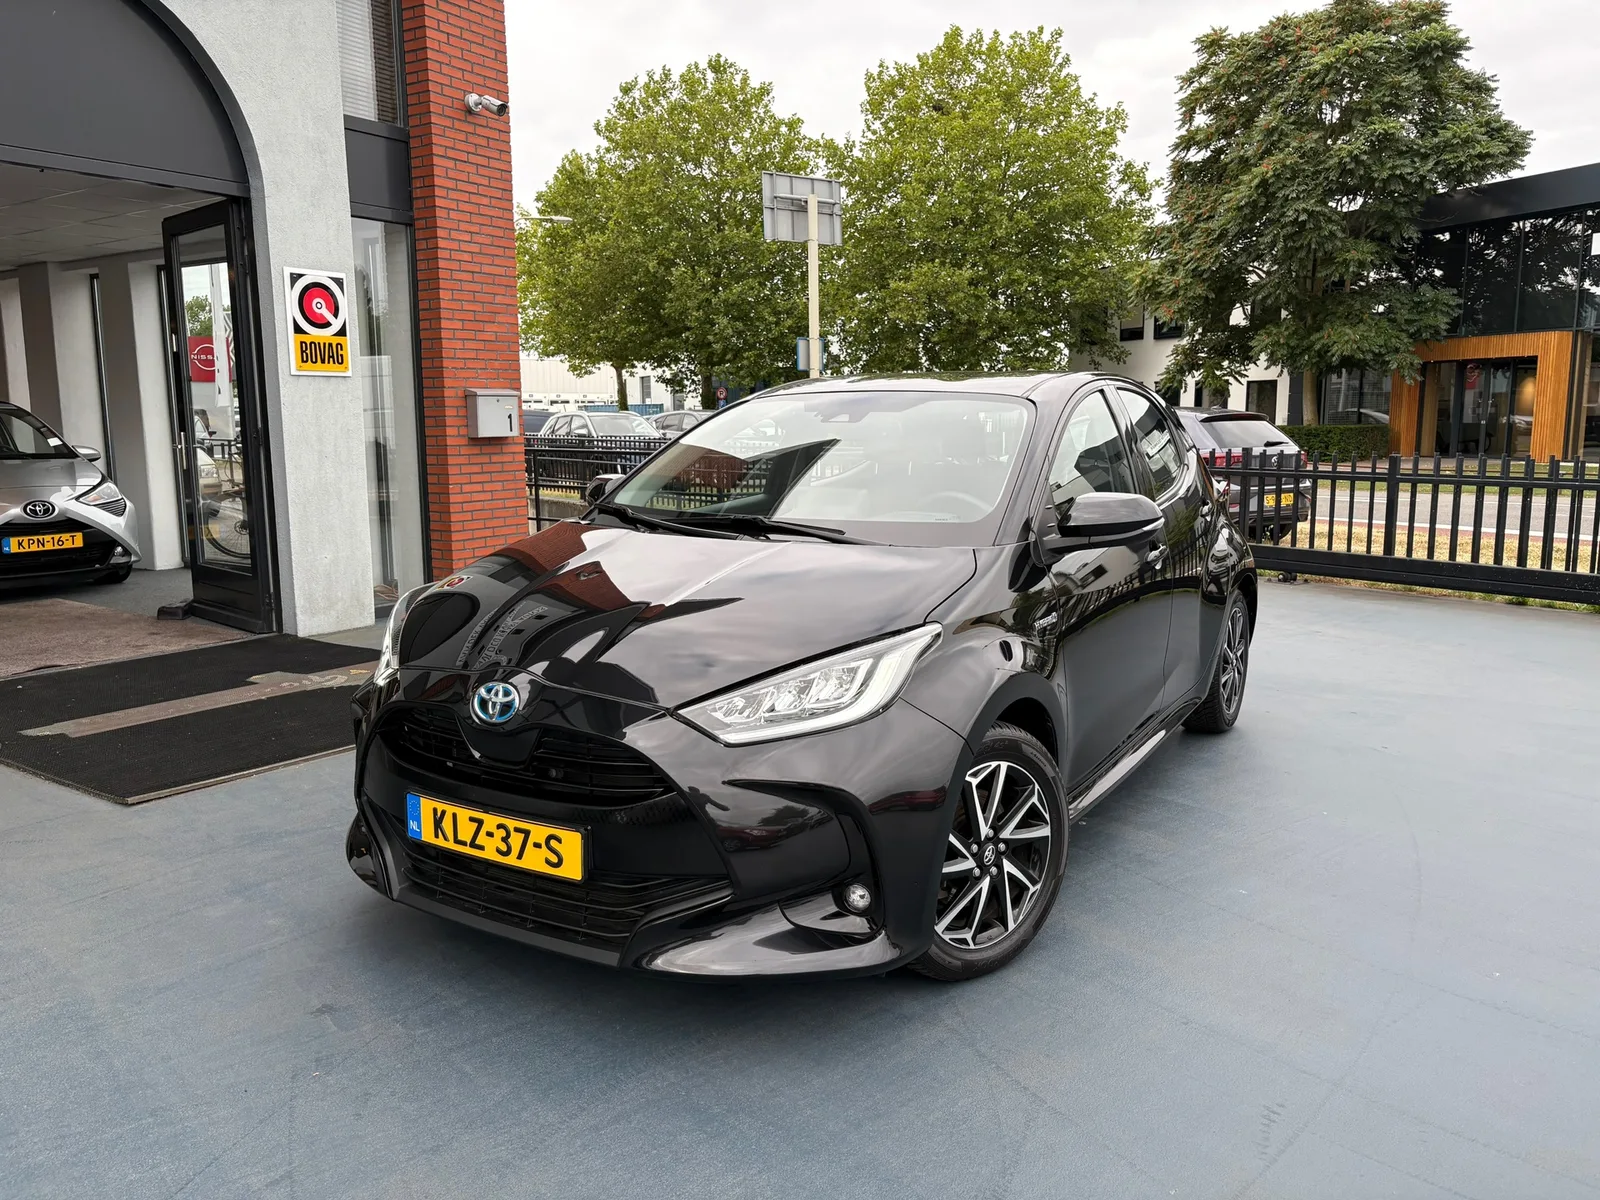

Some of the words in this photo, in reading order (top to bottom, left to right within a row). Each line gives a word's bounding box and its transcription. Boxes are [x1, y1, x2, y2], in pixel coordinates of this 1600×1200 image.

[300, 341, 344, 365] BOVAG
[507, 413, 513, 432] 1
[1265, 494, 1293, 505] S-9-ND
[17, 535, 77, 550] KPN-16-T
[409, 819, 420, 832] NL
[432, 806, 564, 869] KLZ-37-S
